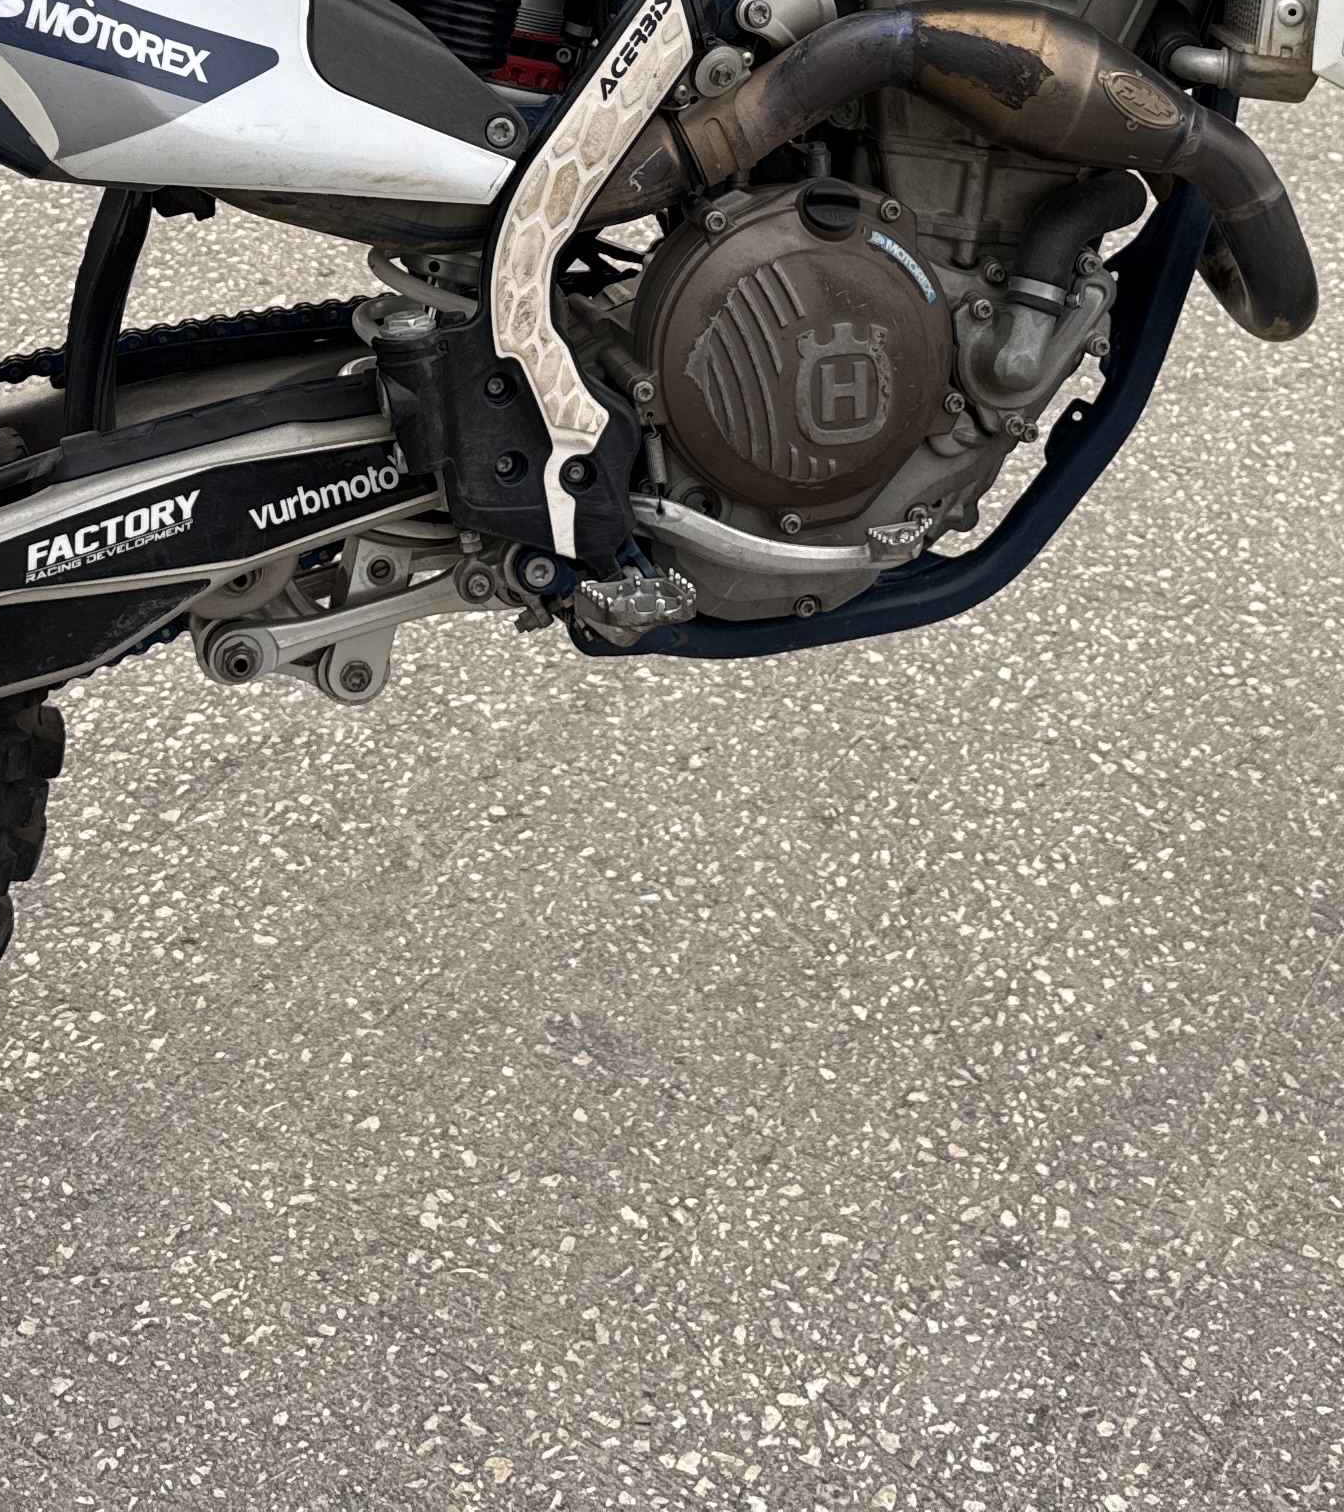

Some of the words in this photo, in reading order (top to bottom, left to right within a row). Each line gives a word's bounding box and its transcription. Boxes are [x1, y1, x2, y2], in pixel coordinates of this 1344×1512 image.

[27, 489, 201, 571] FACTORY
[249, 465, 399, 530] vurbmoto
[25, 559, 82, 584] RACING
[85, 519, 194, 565] DEVELOPMENT
